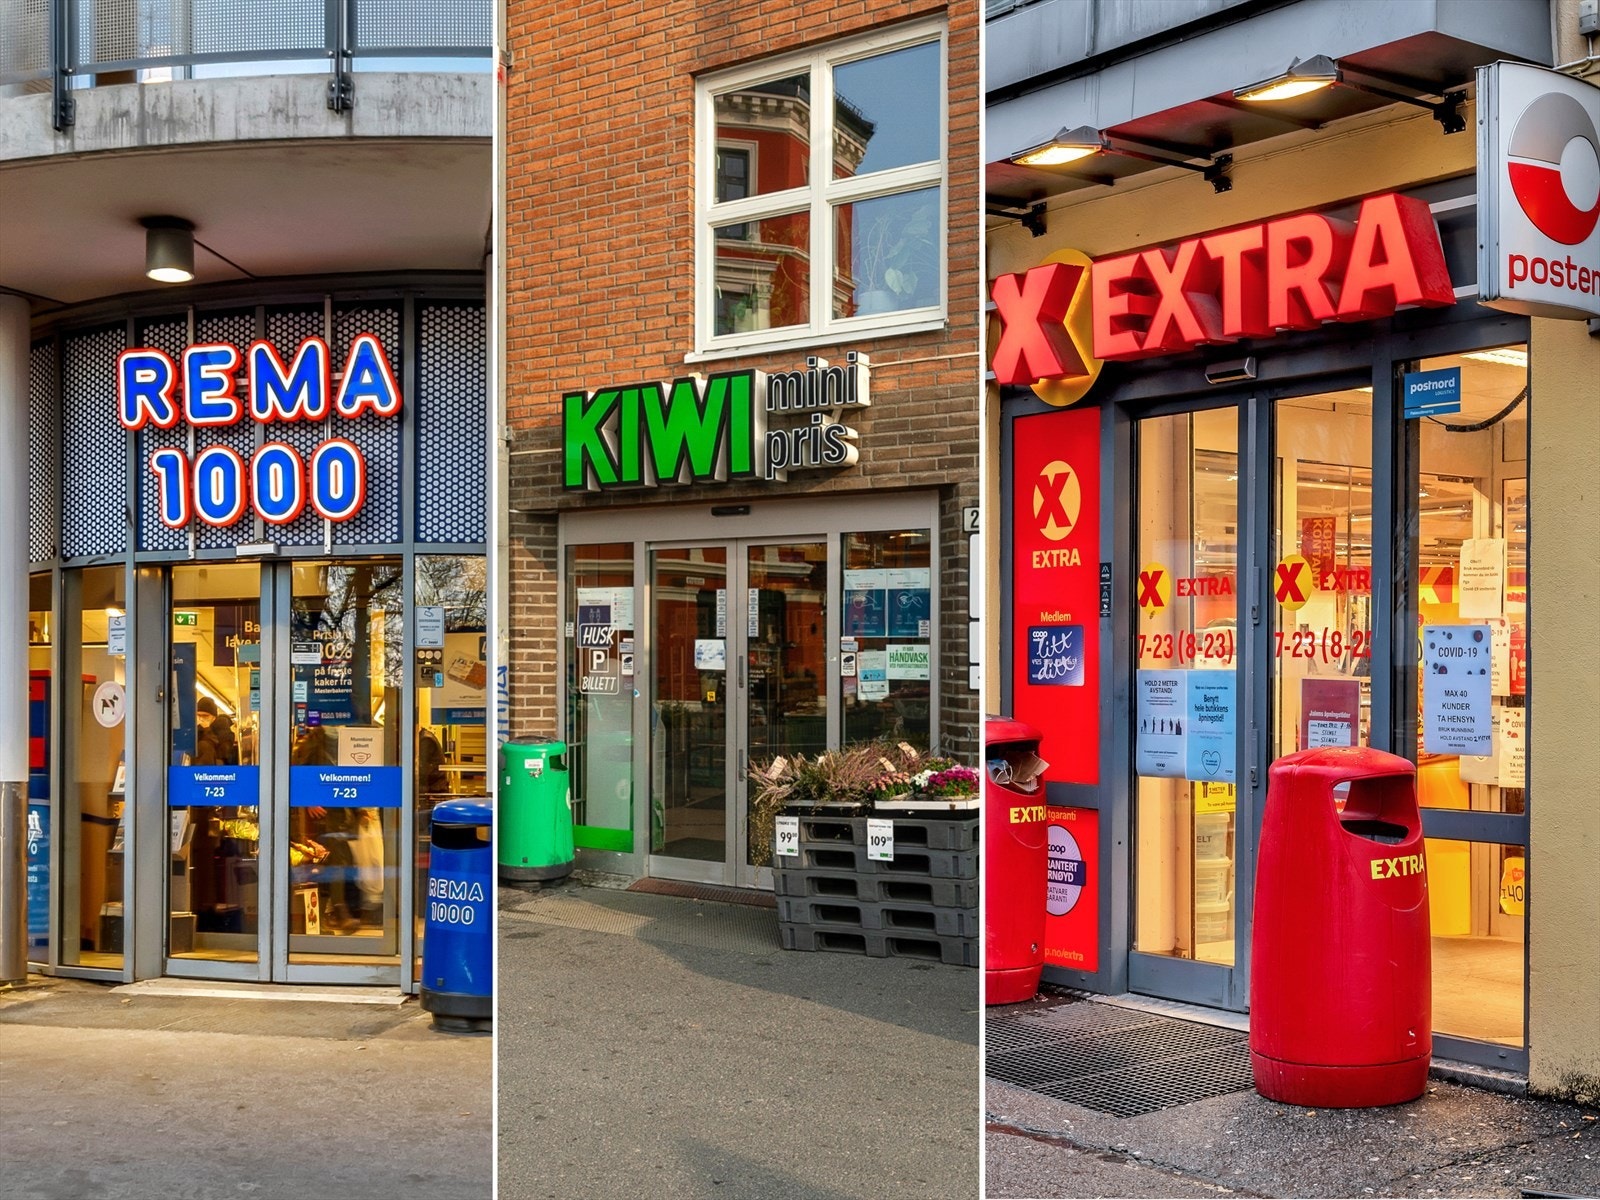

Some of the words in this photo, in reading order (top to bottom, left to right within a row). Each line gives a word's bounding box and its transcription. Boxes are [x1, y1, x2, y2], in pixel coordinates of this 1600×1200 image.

[1092, 192, 1426, 361] EXTRA
[1508, 254, 1600, 296] posten
[118, 333, 402, 430] REMA
[765, 351, 858, 411] mini
[1410, 377, 1455, 395] postnord
[562, 368, 756, 491] KIWI
[764, 412, 847, 480] pris
[151, 438, 366, 528] 1000
[1032, 548, 1081, 569] EXTRA
[1176, 577, 1232, 597] EXTRA
[1320, 570, 1372, 591] EXTR
[1040, 610, 1072, 622] Medlem
[582, 627, 615, 645] HUSK
[1275, 631, 1316, 658] 7-23
[1138, 633, 1174, 659] 7-23
[1178, 629, 1234, 664] (8-23)
[1438, 646, 1478, 658] COVID-19
[592, 650, 605, 670] P
[889, 650, 928, 663] HÅNDVASK
[314, 666, 325, 676] på
[314, 678, 338, 686] kaker
[340, 678, 353, 686] fra
[582, 676, 616, 691] BILLETT
[1203, 695, 1219, 704] Benytt
[1444, 689, 1458, 698] MAX
[1459, 690, 1468, 698] 40
[1194, 704, 1205, 712] hele
[1206, 704, 1229, 713] butikkens
[1441, 702, 1471, 710] KUNDER
[1437, 714, 1446, 722] TA
[1447, 715, 1475, 723] HENSYN
[194, 773, 236, 782] Velkommen!
[320, 773, 371, 783] Velkommen!
[205, 787, 225, 798] 7-23
[333, 788, 358, 799] 7-23
[780, 831, 792, 843] 99
[870, 836, 886, 847] 109
[1370, 853, 1425, 880] EXTRA
[429, 878, 484, 902] REMA
[431, 902, 474, 925] 1000
